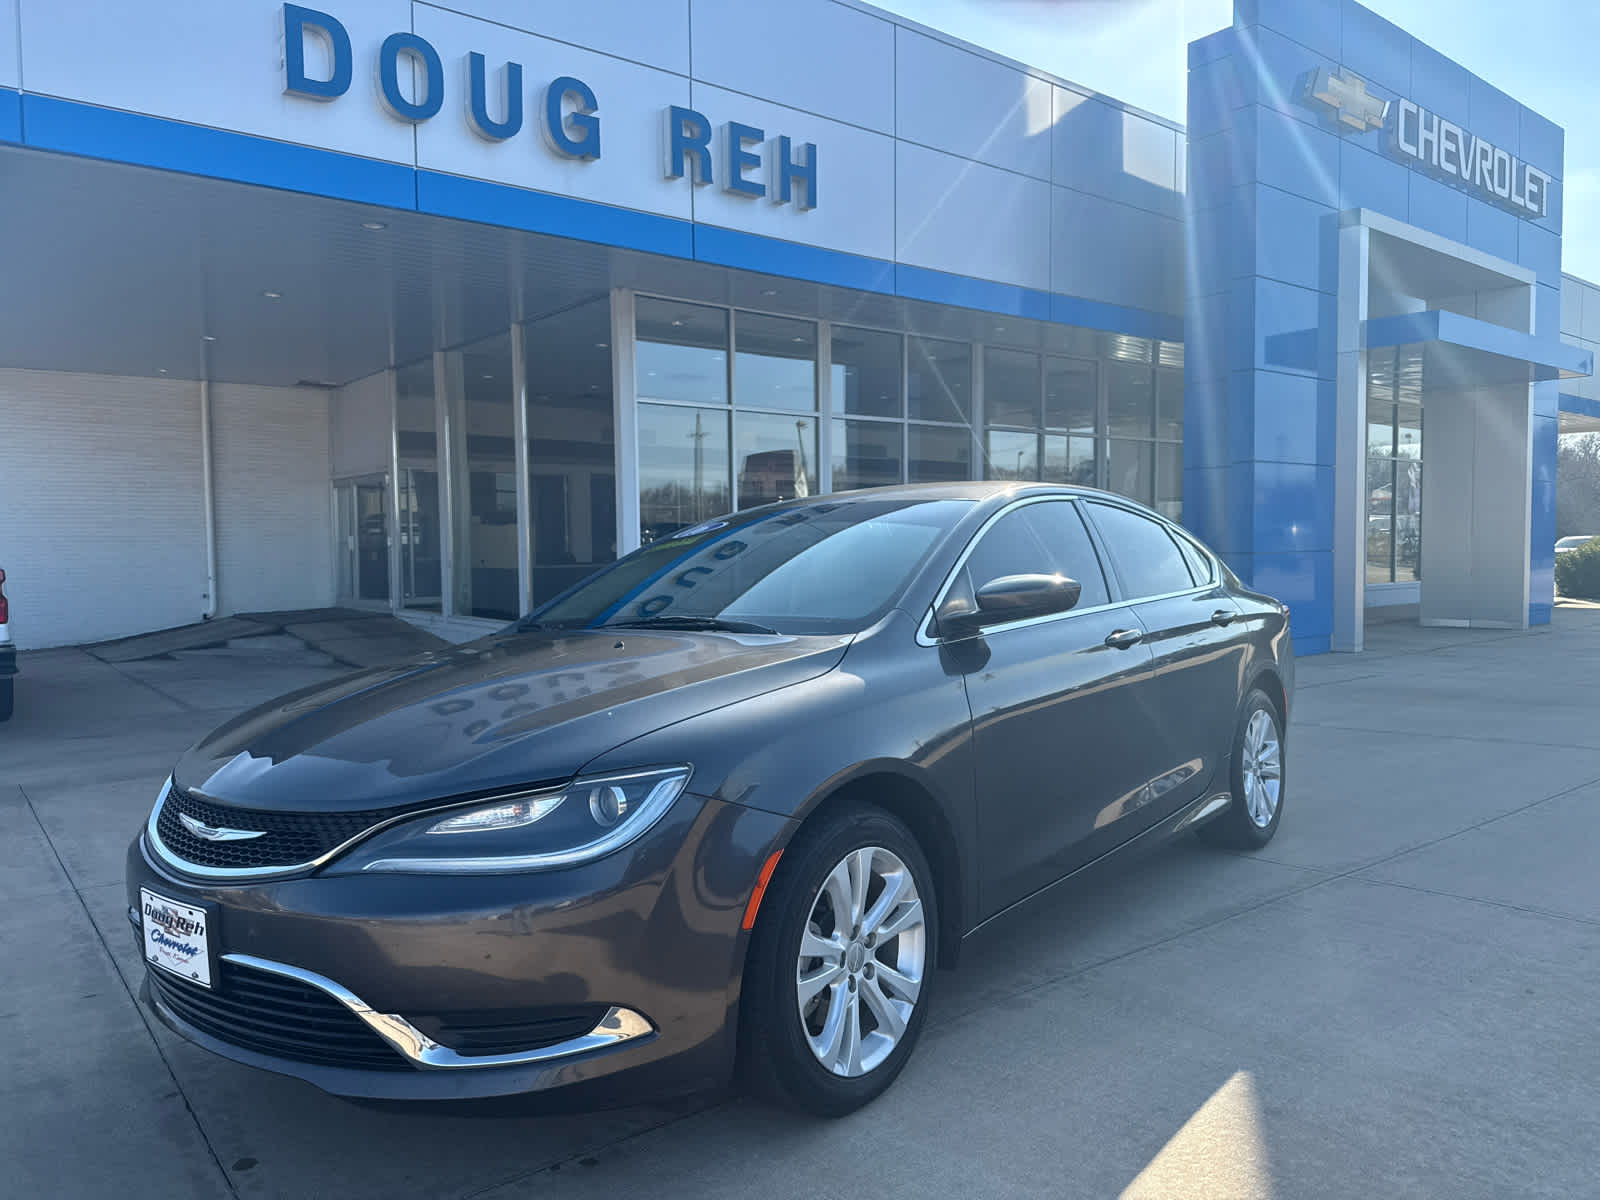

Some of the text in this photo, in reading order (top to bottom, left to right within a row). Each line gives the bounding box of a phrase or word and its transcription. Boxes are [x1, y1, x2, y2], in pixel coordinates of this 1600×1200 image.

[282, 2, 817, 211] DOUG REH
[1398, 98, 1552, 217] CHEVROLET
[144, 903, 205, 937] Doug Reh
[151, 928, 199, 957] Chevrolet
